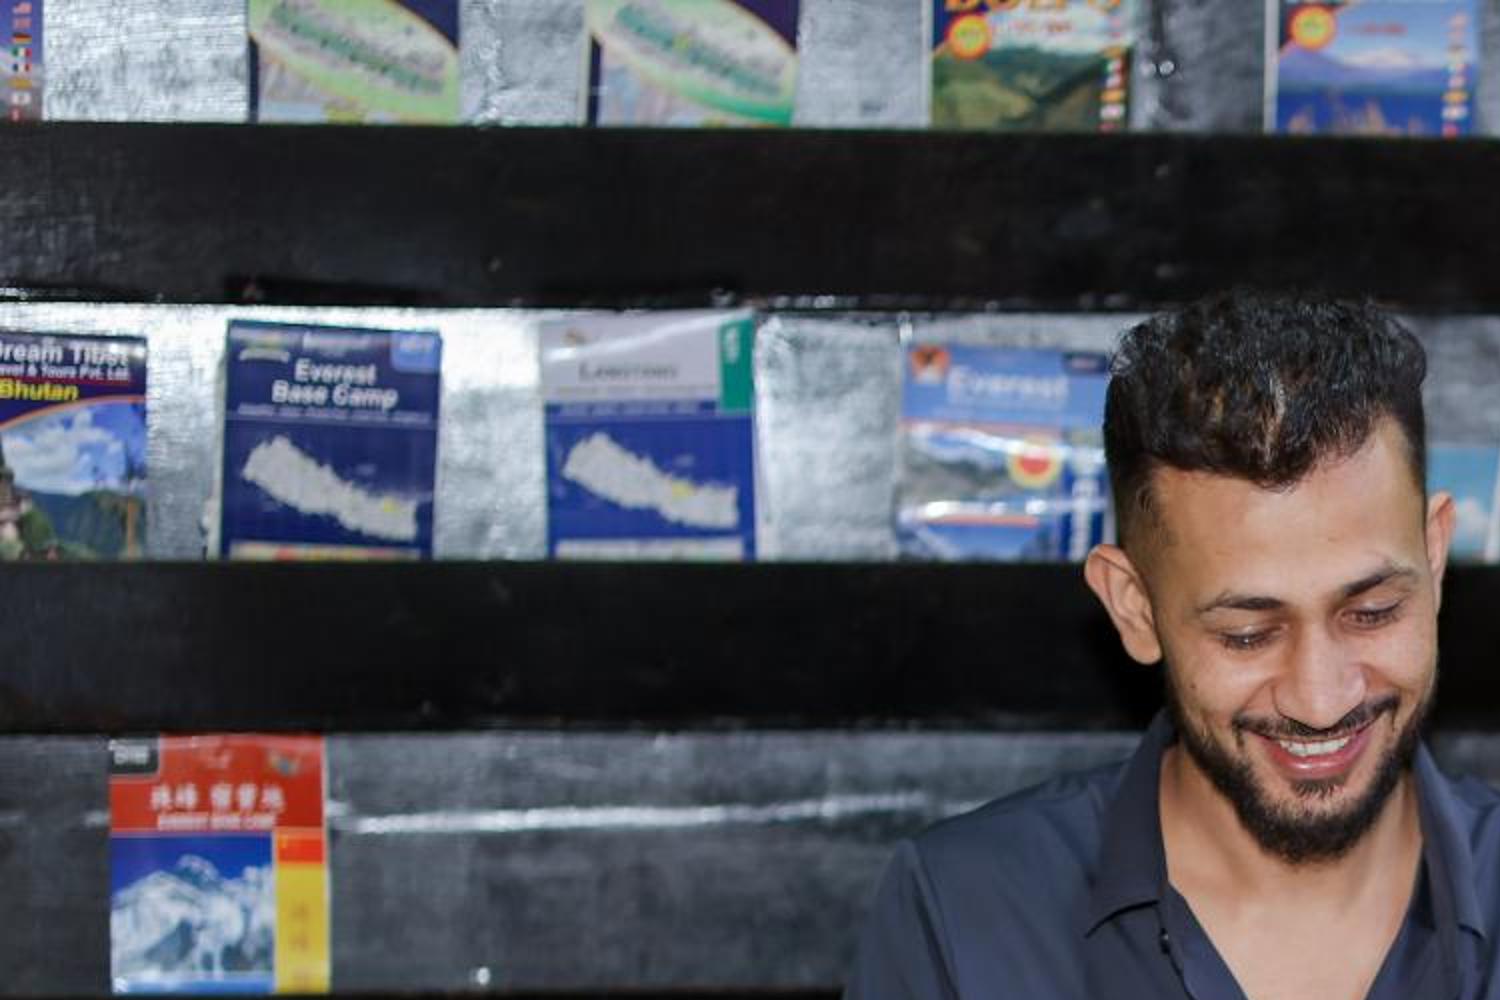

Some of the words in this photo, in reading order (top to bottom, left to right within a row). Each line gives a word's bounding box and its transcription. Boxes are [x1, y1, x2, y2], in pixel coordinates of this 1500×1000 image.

[0, 340, 63, 363] ream
[294, 358, 377, 386] Everest
[0, 379, 79, 400] Bhutan
[271, 379, 329, 406] Base
[332, 383, 399, 413] Camp
